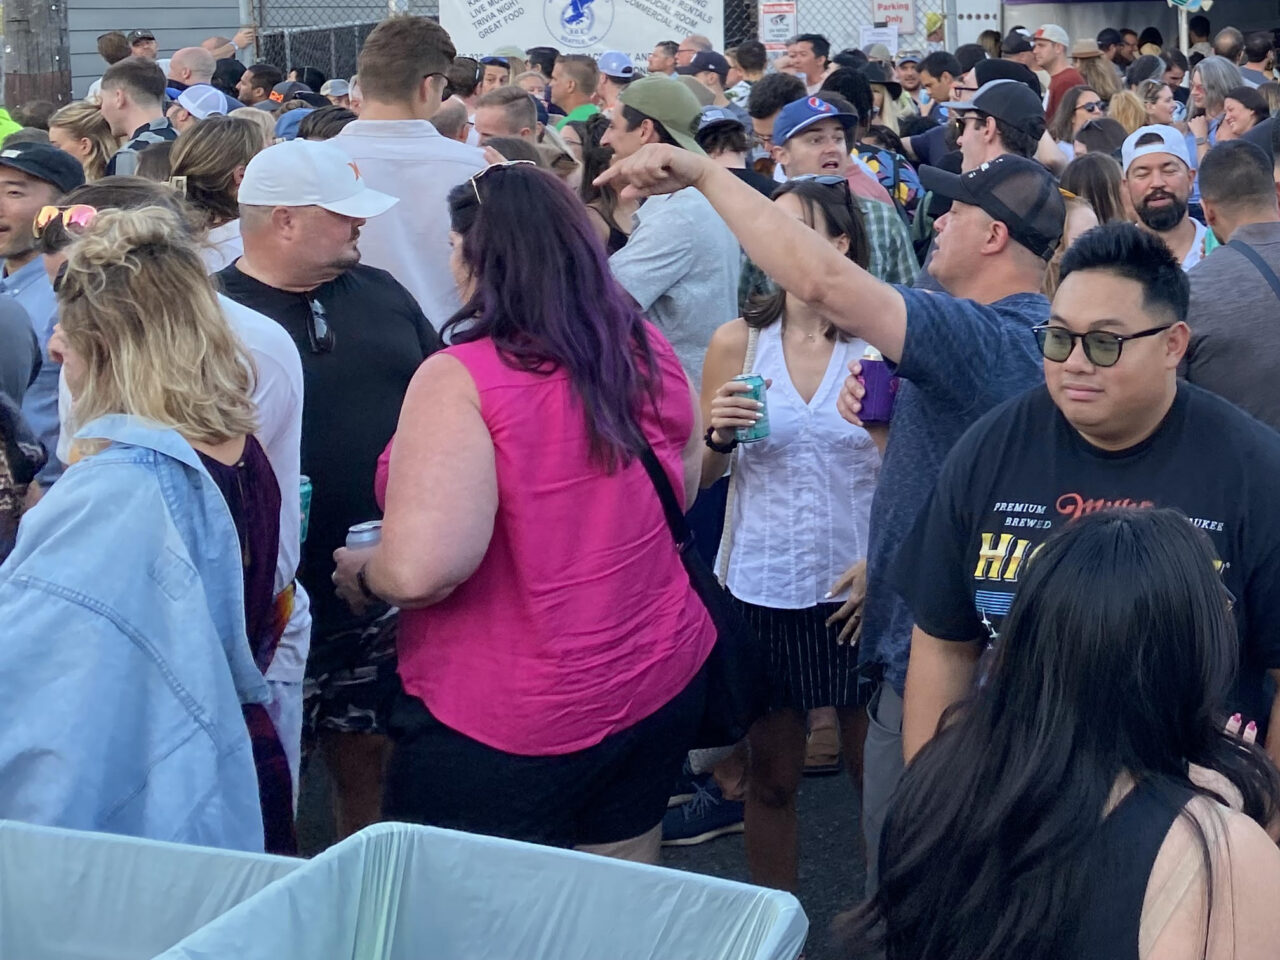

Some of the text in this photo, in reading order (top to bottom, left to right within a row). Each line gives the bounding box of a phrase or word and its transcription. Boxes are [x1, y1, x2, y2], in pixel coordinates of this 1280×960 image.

[470, 4, 487, 19] LIVE
[678, 0, 714, 24] RENTALS
[878, 2, 910, 12] Parking
[472, 12, 497, 30] TRIVIA
[478, 7, 525, 40] GREAT FOOD
[674, 10, 698, 29] ROOM
[885, 15, 903, 24] Only
[993, 502, 1048, 514] PREMIUM
[1004, 517, 1052, 529] BREWED
